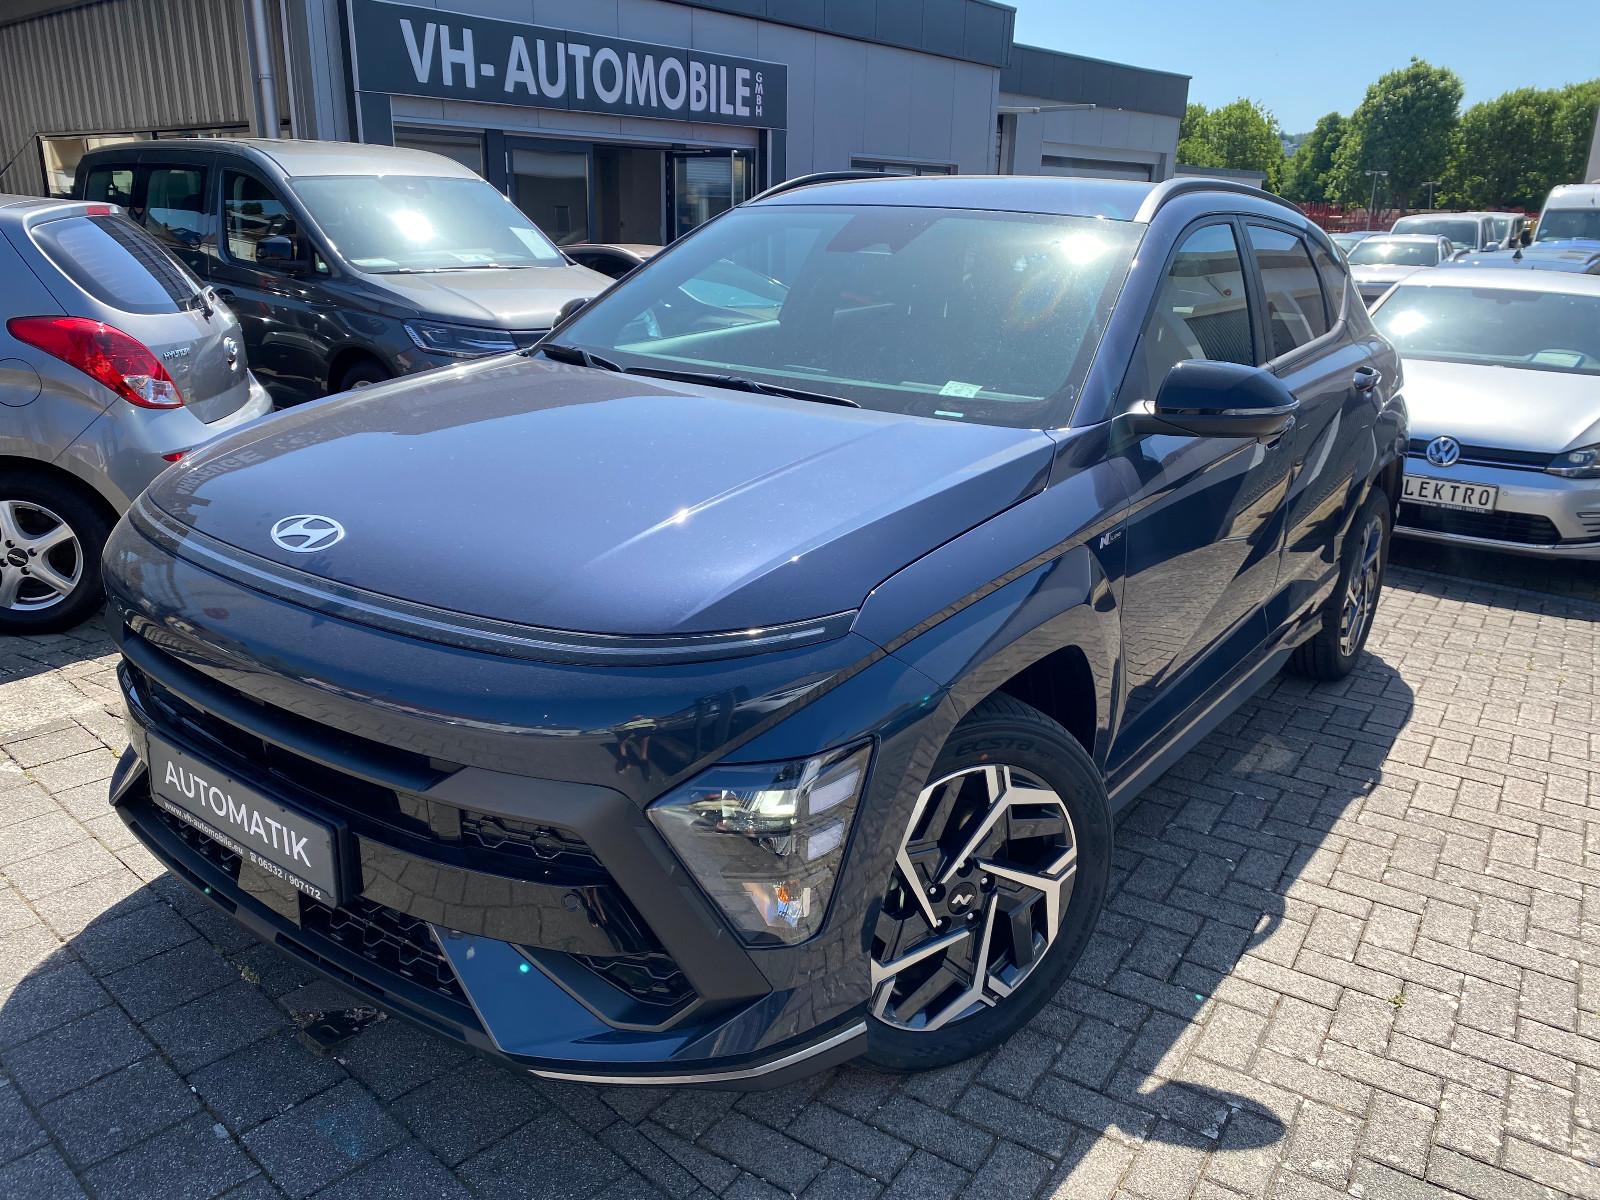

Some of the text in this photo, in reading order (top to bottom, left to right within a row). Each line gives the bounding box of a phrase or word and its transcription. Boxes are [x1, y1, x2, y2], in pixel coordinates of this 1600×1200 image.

[400, 19, 751, 117] VH- AUTOMOBILE
[755, 71, 763, 117] GMBH
[164, 801, 244, 855] www.vh-automobile.eu
[258, 857, 284, 879] 06332
[289, 874, 322, 900] 907172
[165, 760, 312, 868] AUTOMATIK
